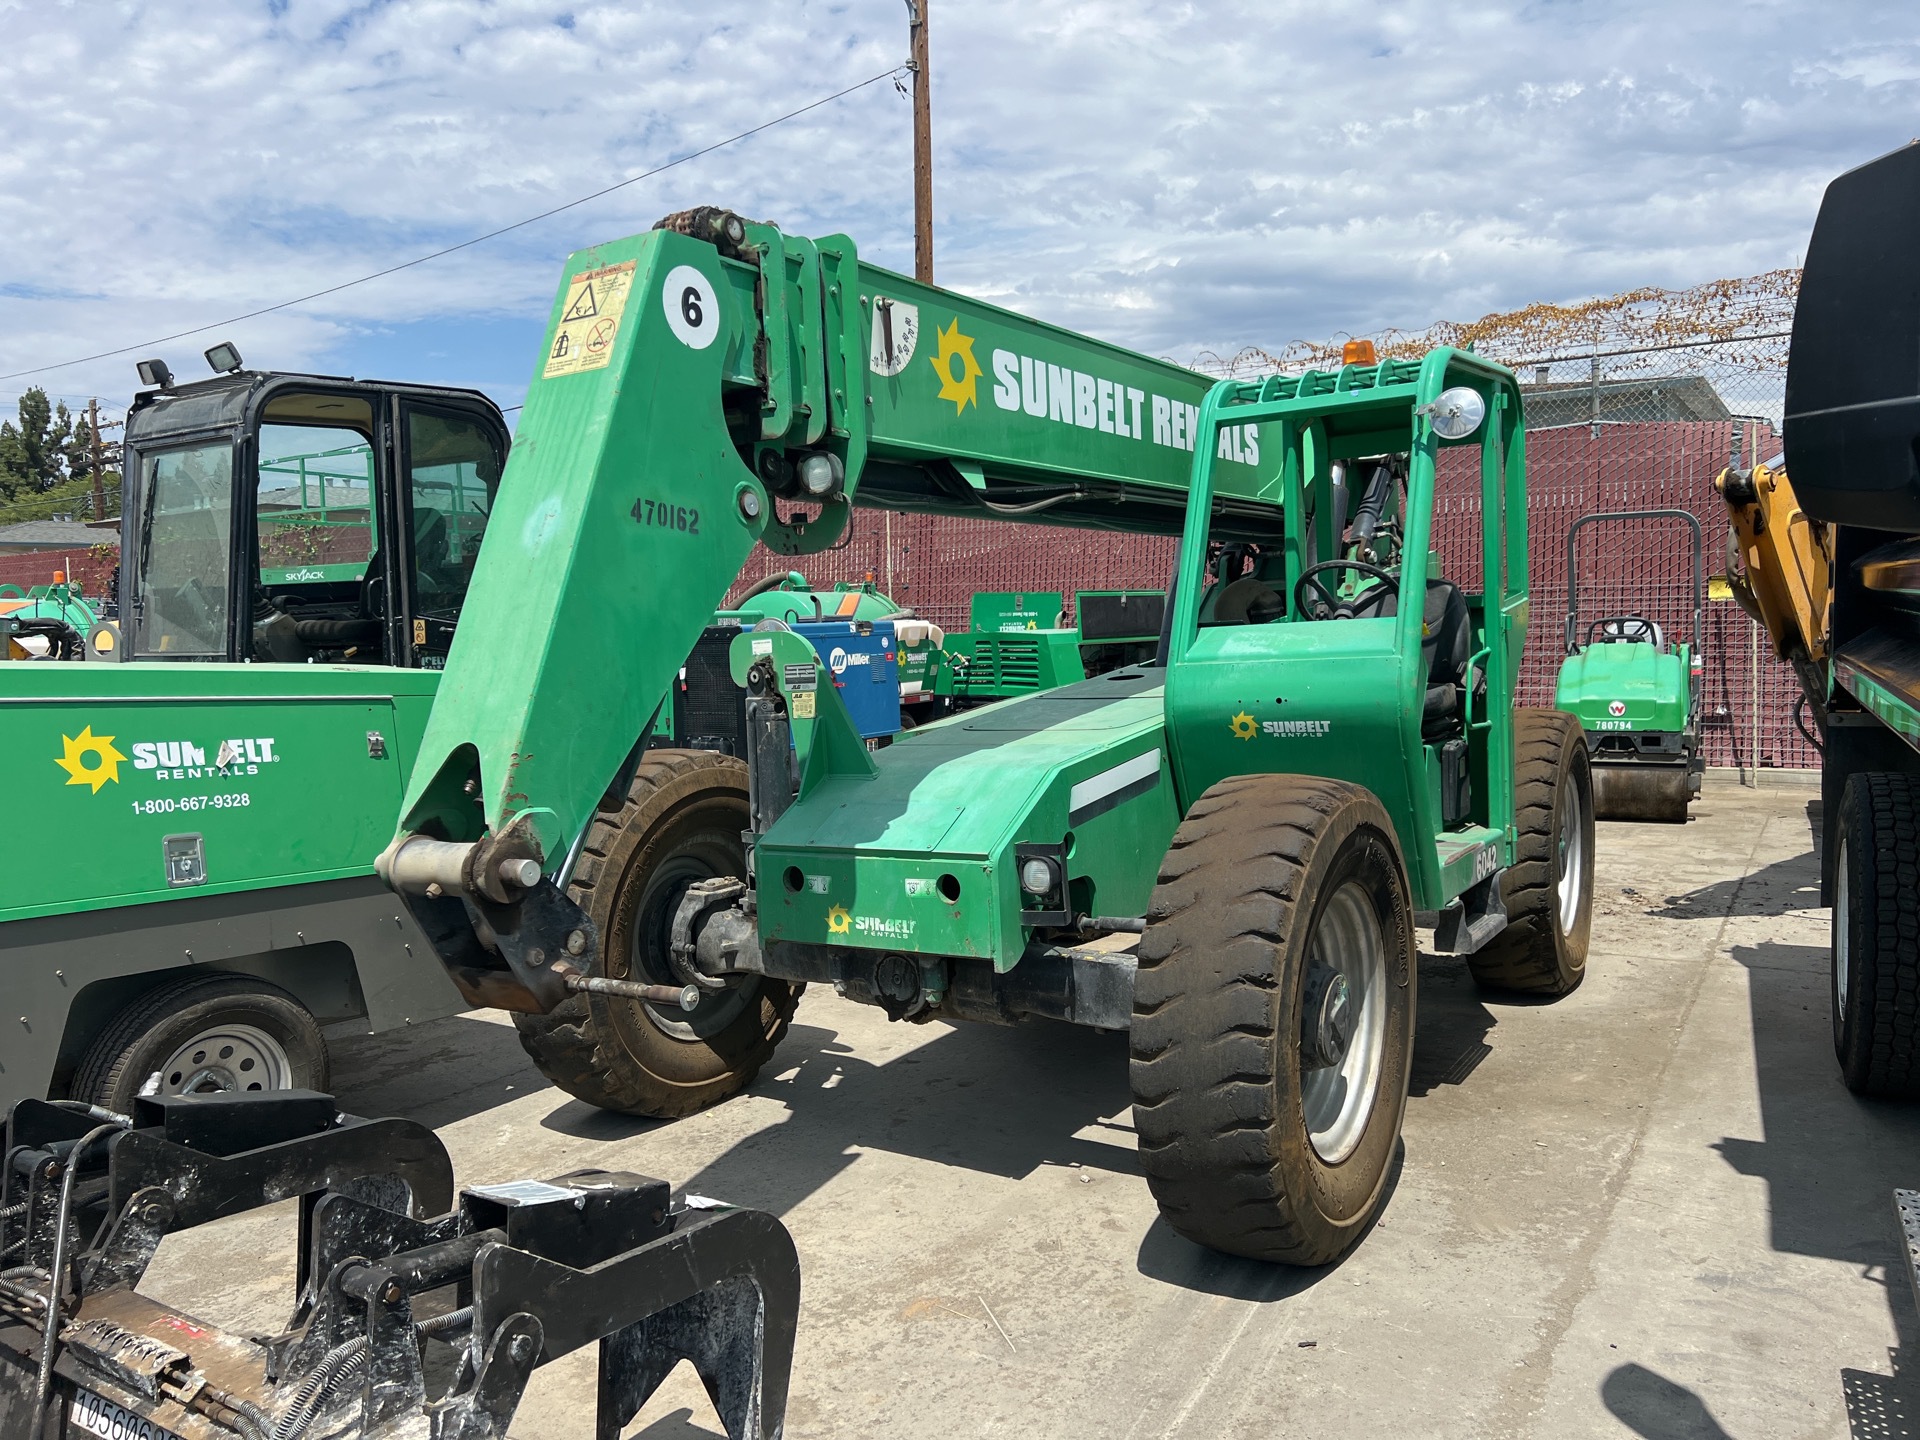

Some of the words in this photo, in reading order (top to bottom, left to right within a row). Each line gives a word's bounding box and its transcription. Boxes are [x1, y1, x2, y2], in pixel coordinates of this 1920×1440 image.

[681, 286, 702, 328] 6
[992, 347, 1145, 441] SUNBELT
[1153, 393, 1260, 467] RENALS
[629, 498, 700, 536] 470162
[285, 569, 324, 582] SKYJACK
[847, 653, 870, 666] Miller
[1262, 720, 1331, 733] SUNBELT
[1595, 720, 1632, 730] 780794
[132, 738, 275, 770] SUNELT
[156, 764, 259, 781] RENTALS
[131, 793, 250, 815] 1-800-667-9328
[1476, 844, 1497, 881] 6042
[855, 915, 917, 934] SUNBELT
